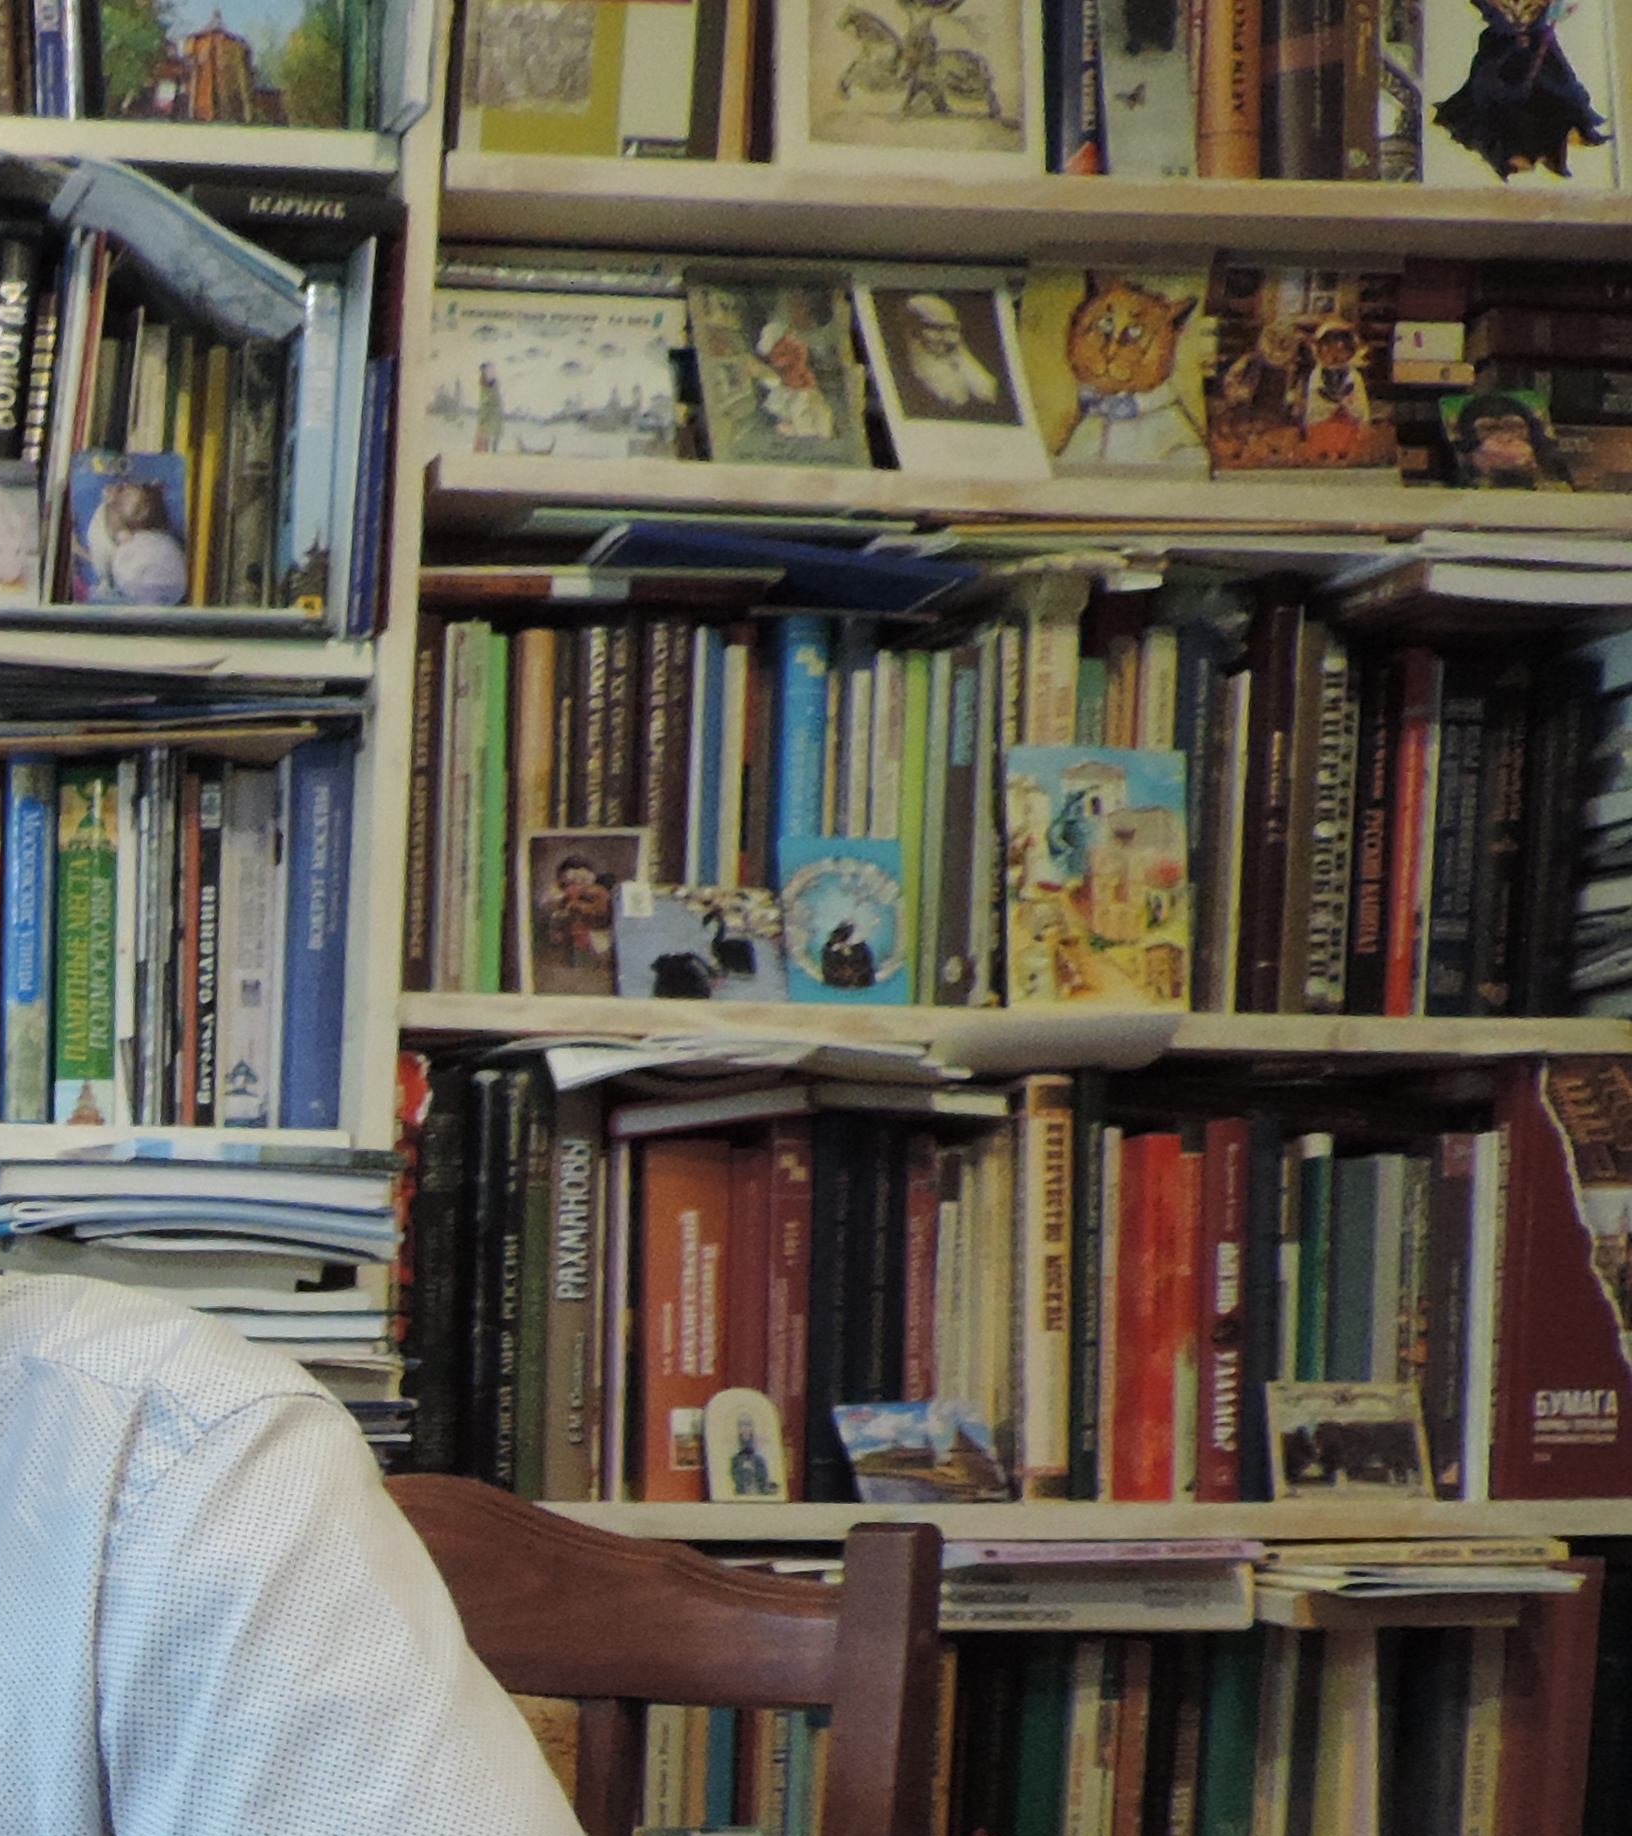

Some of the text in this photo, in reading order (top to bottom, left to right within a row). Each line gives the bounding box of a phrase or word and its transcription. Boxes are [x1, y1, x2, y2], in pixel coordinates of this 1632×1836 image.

[64, 857, 90, 1062] ПАМЯТНЫЕ МЕСТА
[555, 1137, 593, 1301] РАХМАНОВЫ
[1534, 1390, 1619, 1417] БУМАГА
